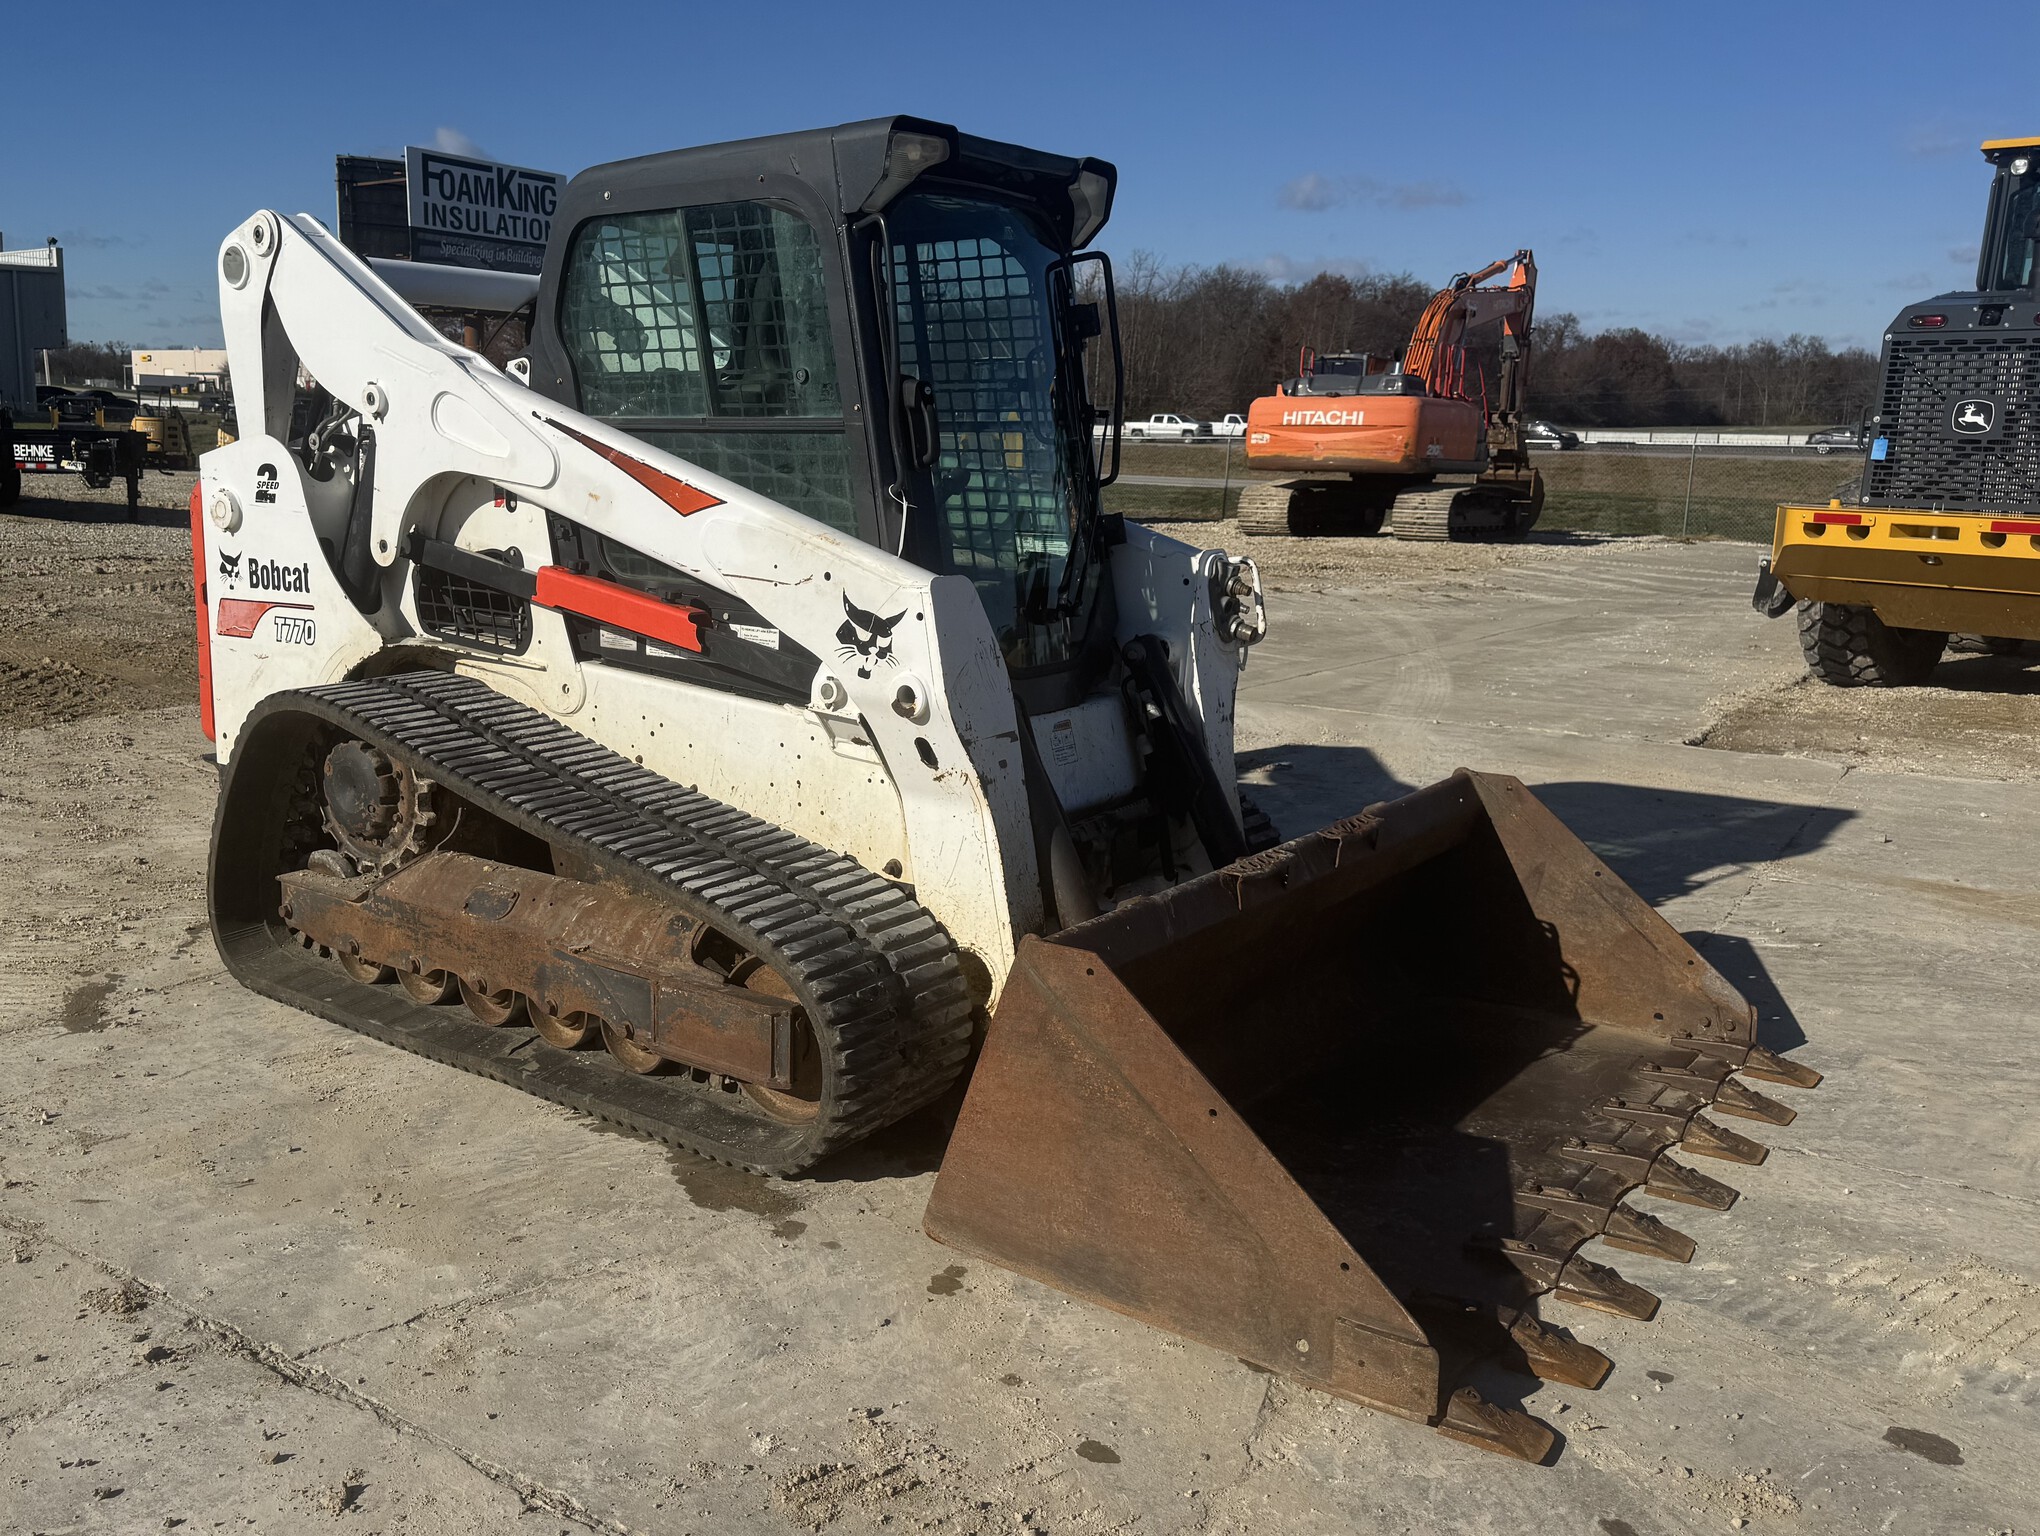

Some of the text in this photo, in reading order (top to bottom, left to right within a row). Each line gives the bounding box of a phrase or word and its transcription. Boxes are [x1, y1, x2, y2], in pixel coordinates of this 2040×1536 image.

[440, 240, 493, 262] Specializing
[1282, 410, 1364, 426] HITACHI
[13, 444, 55, 457] BEHNKE
[256, 481, 280, 490] SPEED
[248, 557, 310, 593] Bobcat
[274, 616, 316, 646] T770
